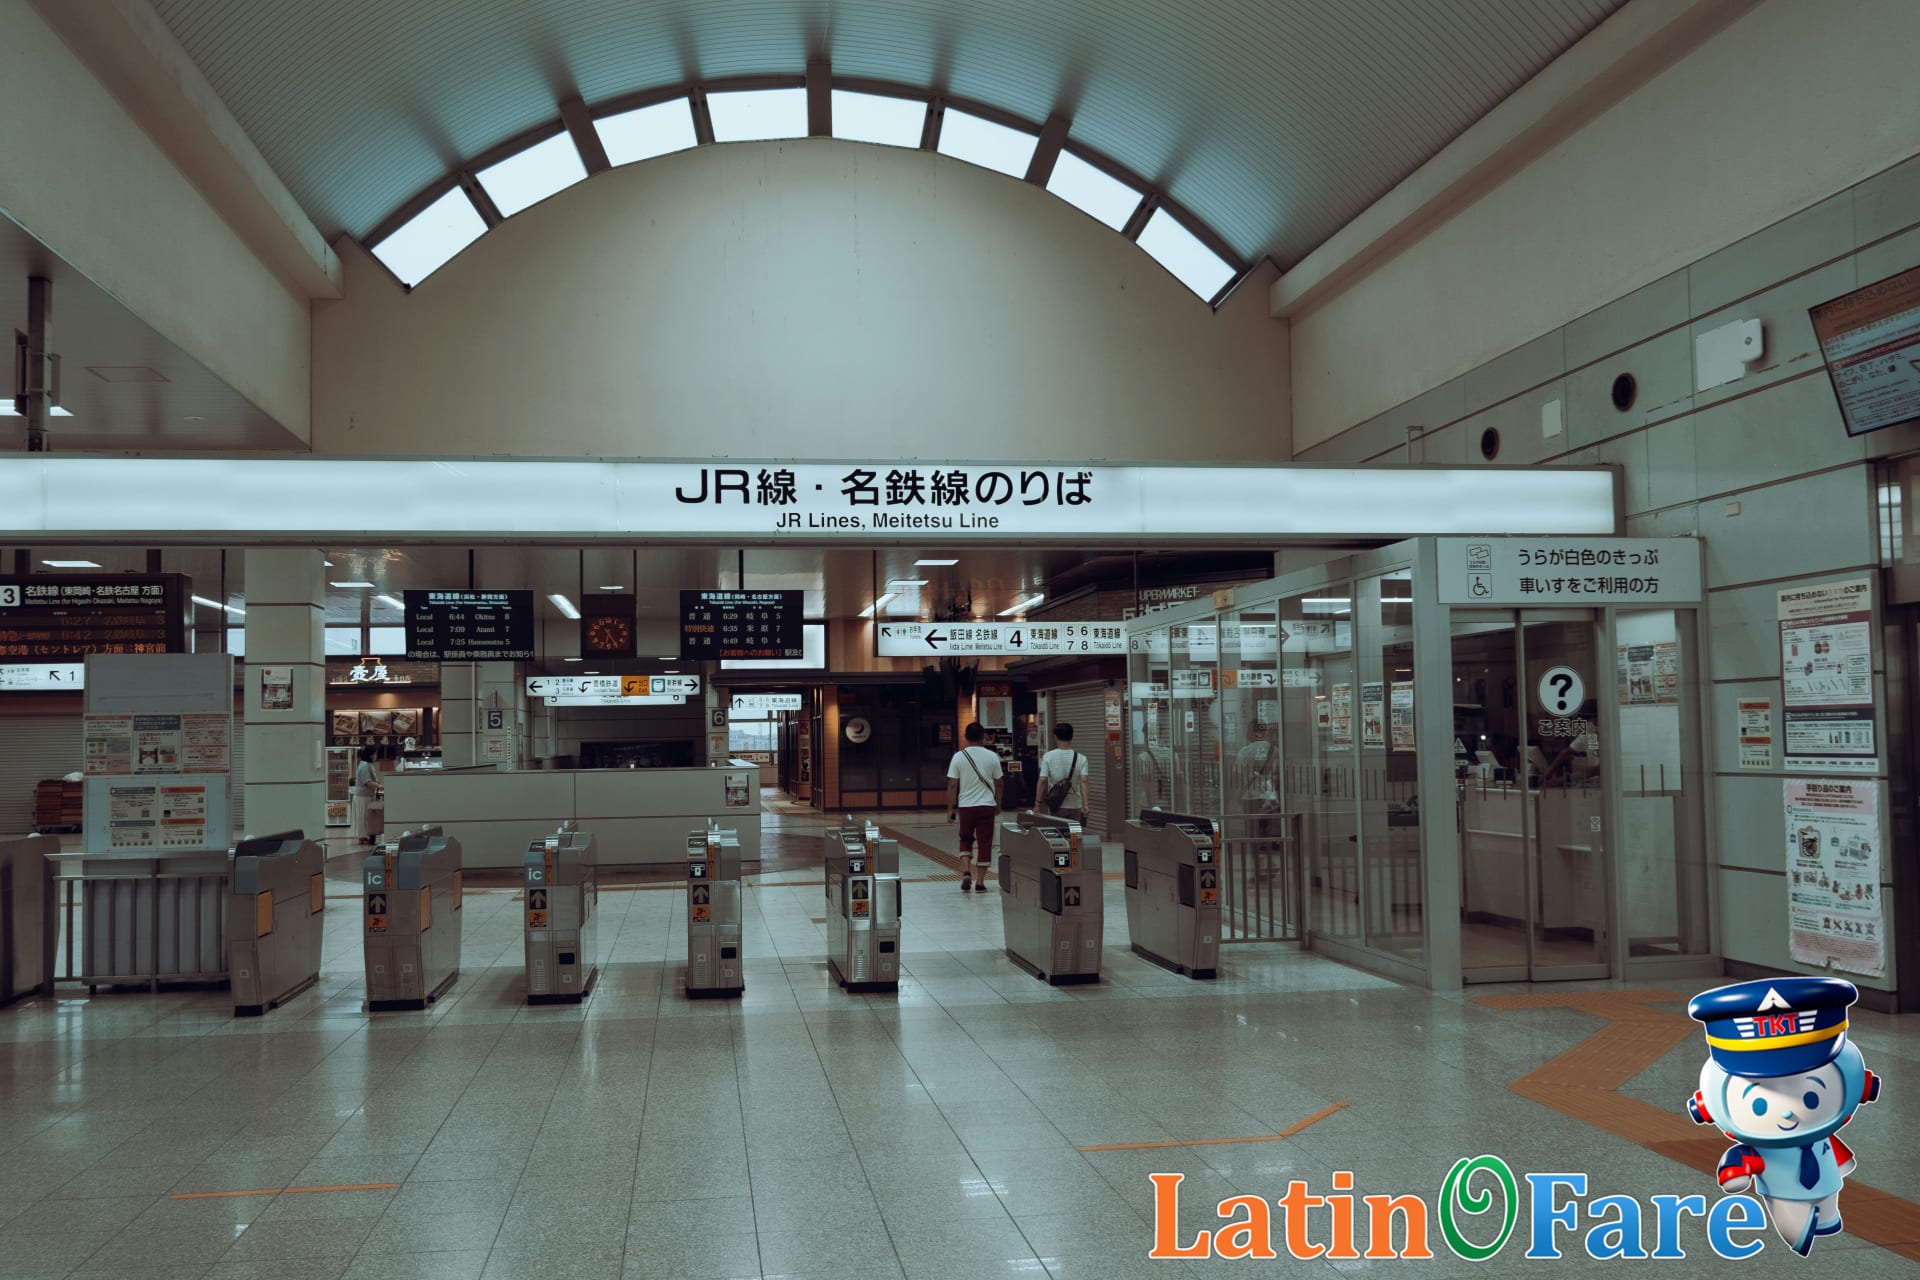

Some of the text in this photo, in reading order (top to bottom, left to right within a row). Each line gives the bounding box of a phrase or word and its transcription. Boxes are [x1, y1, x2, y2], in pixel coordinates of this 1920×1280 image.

[776, 513, 999, 530] JR Lines, Meitetsu Line
[1518, 549, 1659, 566] うらが白色のきっぷ
[1519, 577, 1659, 594] 車いすをご利用の方
[4, 588, 15, 604] 3
[1138, 586, 1198, 601] UPERMARKET
[950, 628, 973, 641] 飯田線
[976, 628, 998, 641] 名鉄線
[1010, 630, 1023, 648] 4
[1030, 628, 1058, 640] 東海道線
[1067, 626, 1074, 636] 5
[1081, 626, 1088, 636] 6
[1093, 628, 1121, 639] 東海道線
[961, 642, 973, 650] Line
[1067, 641, 1074, 650] 7
[1081, 641, 1088, 650] 8
[1113, 641, 1122, 649] Line
[69, 670, 75, 681] 1
[490, 712, 501, 727] 5
[714, 711, 724, 725] 6
[1538, 718, 1588, 738] ご案内
[367, 872, 383, 885] ic
[528, 867, 543, 882] ic
